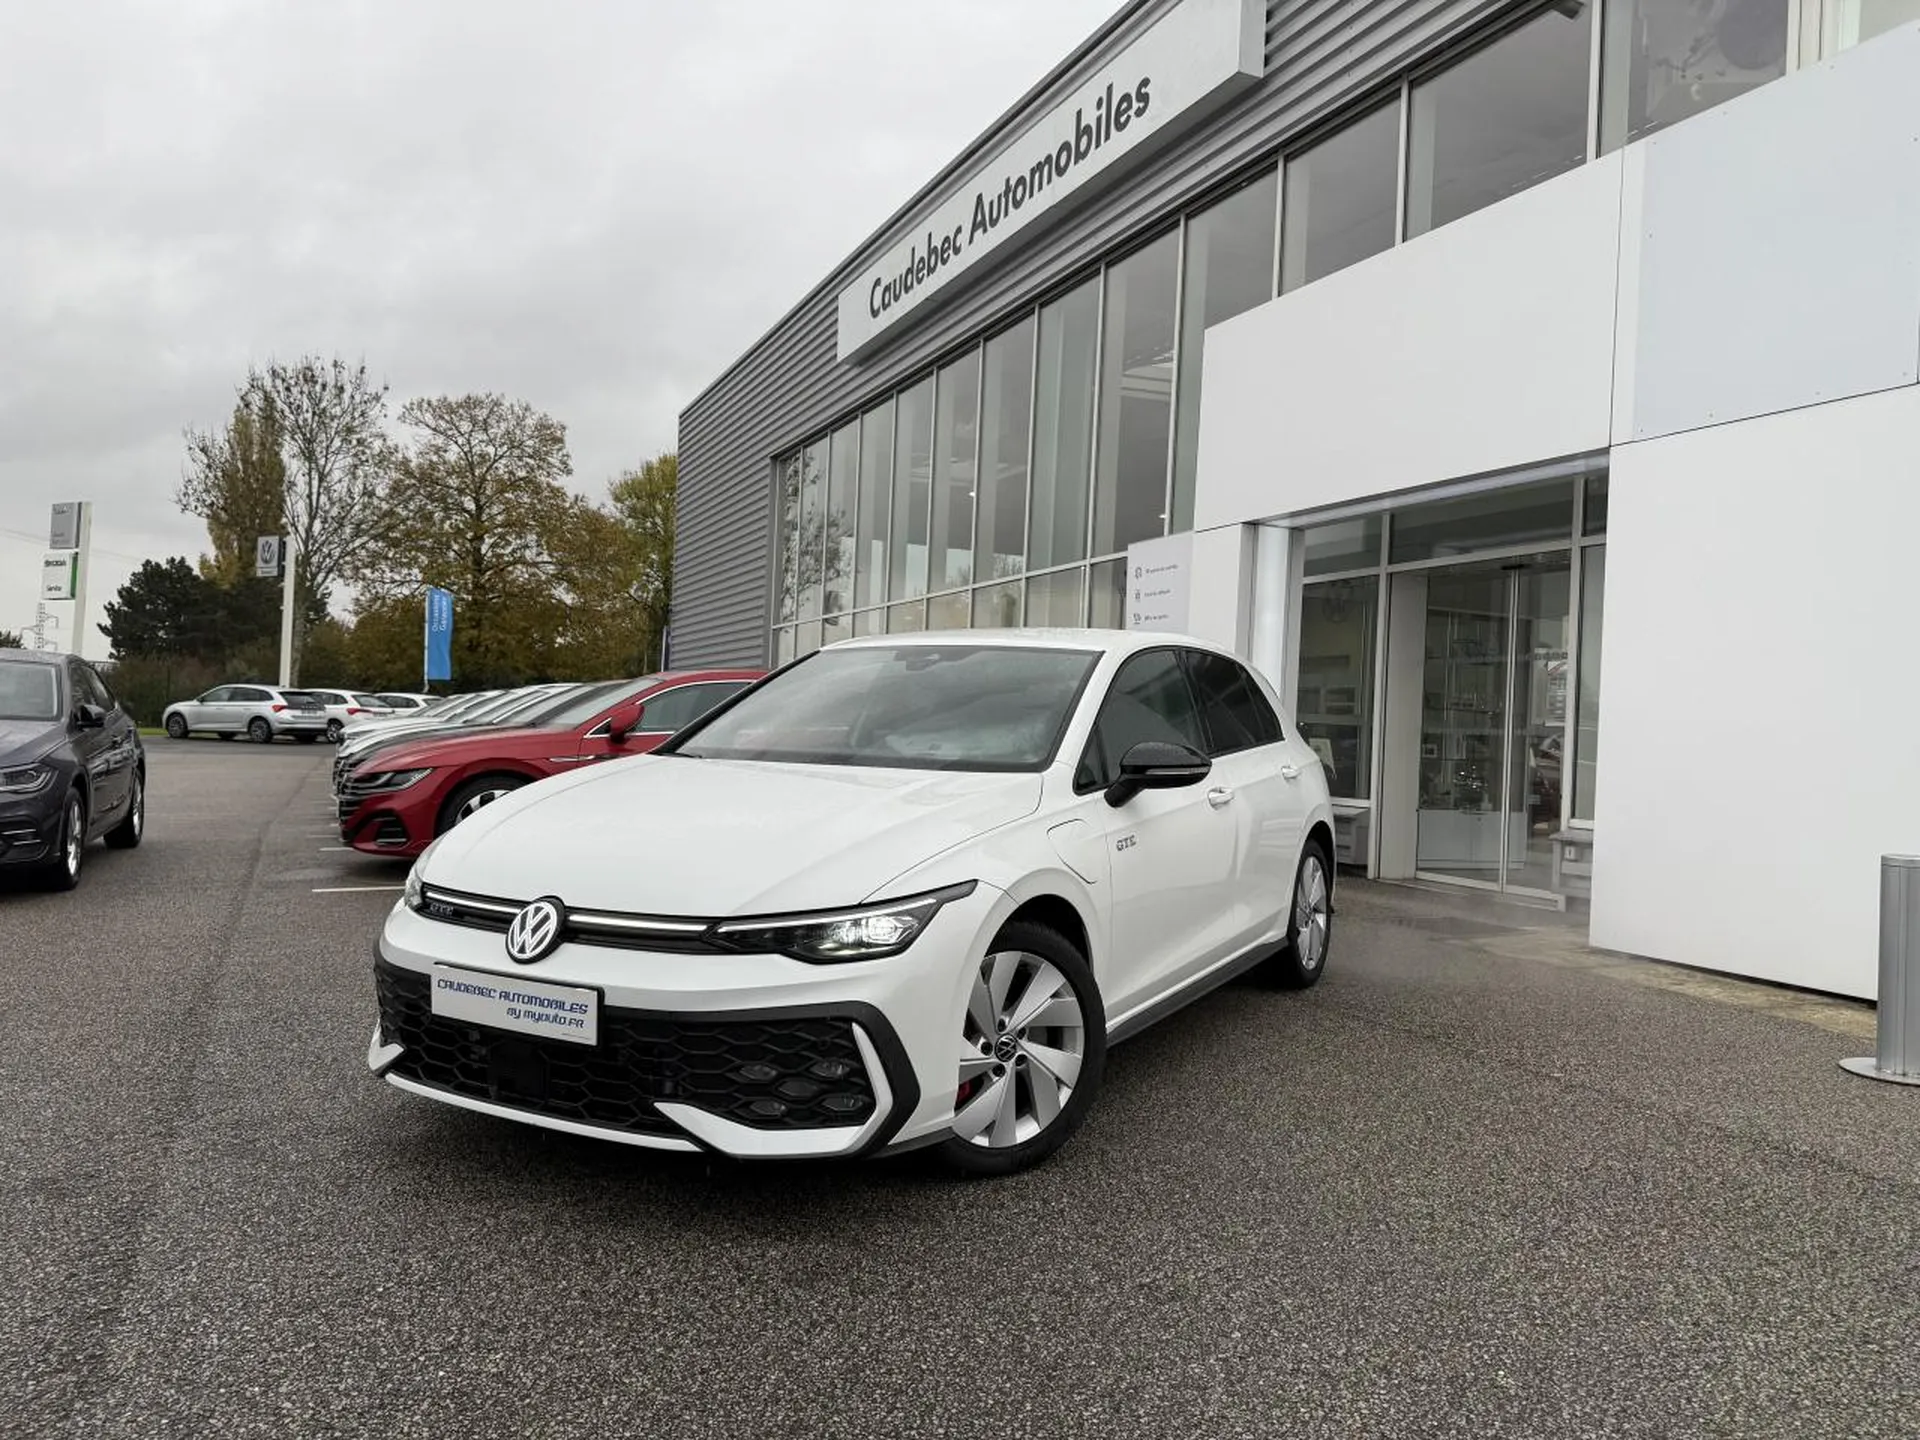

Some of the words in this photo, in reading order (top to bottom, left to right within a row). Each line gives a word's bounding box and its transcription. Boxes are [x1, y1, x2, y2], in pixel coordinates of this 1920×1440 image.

[868, 223, 964, 318] Caudebec
[968, 76, 1152, 245] Automobiles
[437, 978, 497, 999] CAUDEBEC
[499, 990, 588, 1015] AUTOMOBILES
